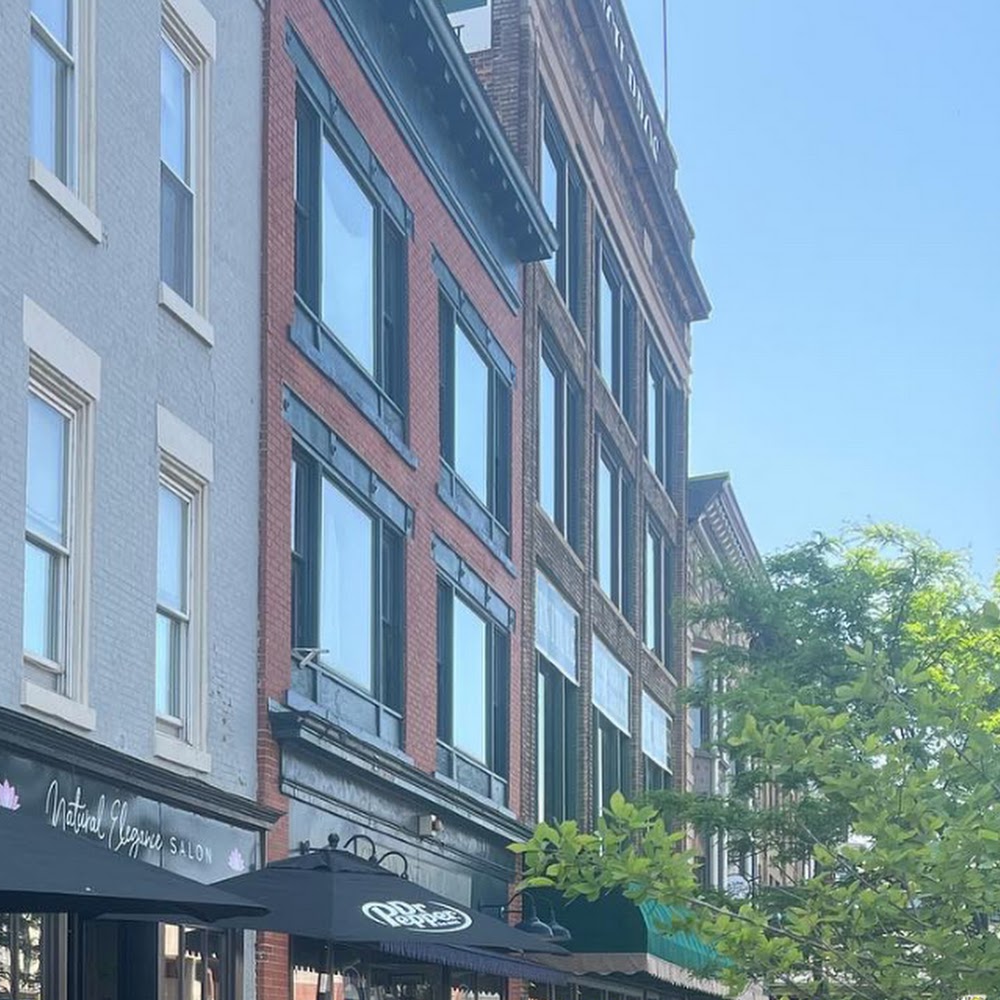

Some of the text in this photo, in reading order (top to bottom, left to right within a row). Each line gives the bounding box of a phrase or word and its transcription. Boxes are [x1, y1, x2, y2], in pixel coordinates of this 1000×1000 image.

[45, 780, 213, 865] Natural Elegance SALON
